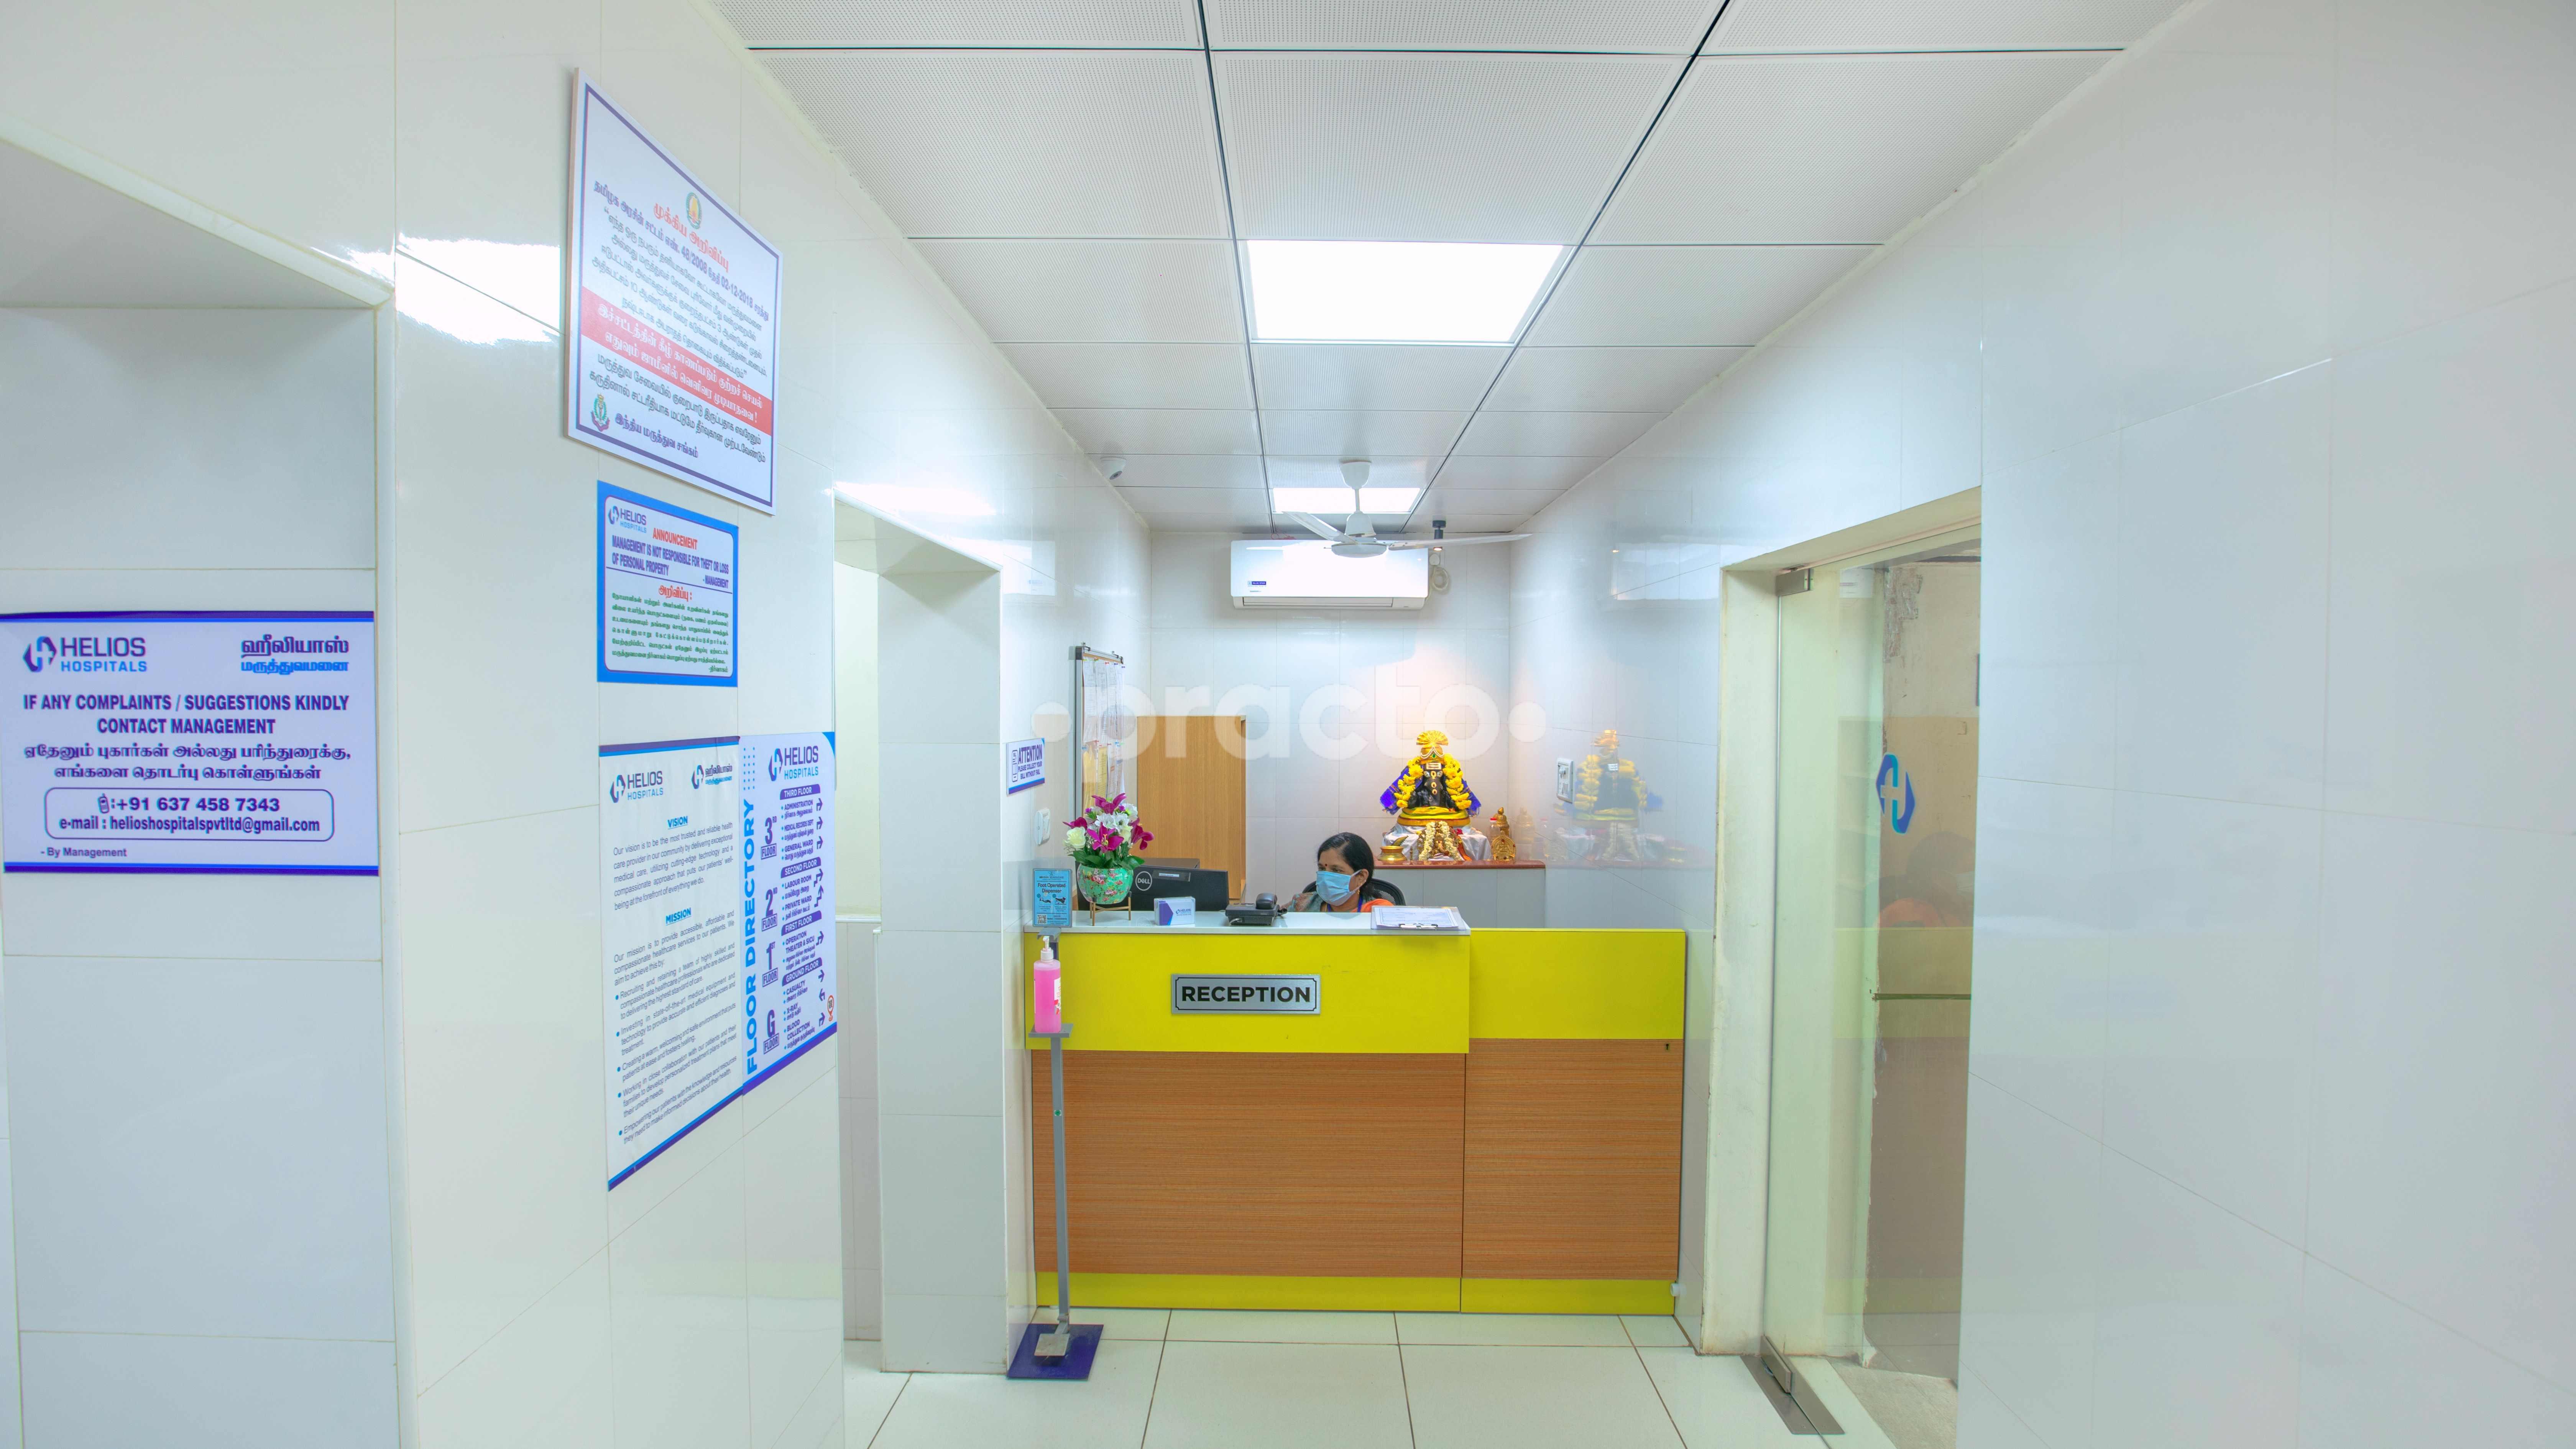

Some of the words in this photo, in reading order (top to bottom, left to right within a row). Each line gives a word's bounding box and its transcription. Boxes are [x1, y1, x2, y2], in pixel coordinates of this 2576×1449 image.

[654, 204, 686, 237] முக்கிய
[605, 332, 638, 357] எதுவும்
[598, 304, 656, 347] இச்சட்டத்தின்
[659, 338, 672, 358] கீழ்
[743, 390, 762, 408] செயல்
[615, 413, 641, 434] இந்திய
[643, 427, 675, 448] மருத்துவ
[677, 442, 698, 458] சங்கம்
[620, 508, 646, 525] HELIOS
[620, 521, 646, 533] HOSPITALS
[653, 528, 697, 549] ANNOUNCEMENT
[612, 535, 646, 554] MANAGEMENT
[647, 544, 651, 555] IS
[652, 545, 661, 557] NOT
[662, 548, 690, 565] RESPONSIBLE
[700, 558, 712, 570] THEFT
[713, 561, 719, 572] OR
[720, 563, 728, 574] LOSS
[612, 552, 618, 564] OF
[620, 554, 644, 570] PERSONAL
[646, 560, 669, 575] PROPERTY
[705, 575, 728, 588] MANAGEMENT
[60, 637, 145, 657] HELIOS
[241, 634, 348, 658] ஹீலியாஸ்
[61, 661, 146, 672] HOSPITALS
[241, 659, 348, 675] மருத்துவமனை
[23, 695, 37, 709] IF
[41, 695, 71, 709] ANY
[75, 695, 171, 710] COMPLAINTS
[184, 695, 291, 710] SUGGESTIONS
[295, 695, 349, 710] KINDLY
[97, 718, 166, 733] CONTACT
[170, 718, 275, 733] MANAGEMENT
[23, 743, 94, 760] ஏதேனும்
[97, 743, 169, 759] புகார்கள்
[172, 743, 237, 761] அல்லது
[785, 746, 818, 766] HELIOS
[1018, 744, 1042, 764] ATTENTION
[54, 763, 128, 777] எங்களை
[132, 764, 198, 781] தொடர்பு
[202, 764, 321, 781] கொள்ளுங்கள்
[627, 771, 662, 789] HELIOS
[785, 767, 818, 779] HOSPITALS
[628, 788, 663, 800] HOSPITALS
[156, 798, 189, 810] 637
[196, 798, 229, 811] 458
[235, 798, 279, 811] 7343
[785, 800, 813, 810] ADMINISTRATION
[59, 816, 98, 829] e-mail
[110, 816, 319, 834] helioshospitalspvtltd@gmail.com
[668, 816, 687, 827] VISION
[681, 830, 696, 840] trusted
[706, 825, 720, 833] reliable
[46, 847, 60, 858] By
[62, 847, 127, 859] Management
[626, 856, 646, 868] provider
[661, 846, 684, 857] community
[691, 840, 710, 849] delivering
[711, 835, 732, 844] exceptional
[762, 846, 775, 857] FLOOR
[785, 843, 802, 852] GENERAL
[614, 873, 634, 883] medical
[651, 863, 668, 873] utilizing
[671, 856, 696, 867] cutting-edge
[699, 849, 720, 859] technology
[785, 864, 802, 875] SECOND
[803, 859, 816, 869] FLOOR
[744, 798, 755, 967] DIRECTORY
[785, 879, 800, 889] LABOUR
[801, 875, 811, 883] ROOM
[785, 900, 800, 910] PRIVATE
[801, 895, 812, 904] WARD
[666, 909, 690, 923] MISSION
[763, 917, 776, 928] FLOOR
[786, 922, 797, 932] FIRST
[798, 915, 812, 927] FLOOR
[786, 931, 806, 945] OPERATION
[786, 941, 802, 953] THEATER
[806, 936, 814, 944] SICU
[763, 971, 776, 984] FLOOR
[787, 968, 804, 982] GROUND
[805, 960, 818, 972] FLOOR
[786, 981, 805, 995] CASUALTY
[1182, 986, 1309, 1002] RECEPTION
[787, 1003, 797, 1014] X-RAY
[746, 973, 757, 1074] FLOOR
[767, 1010, 775, 1038] G
[787, 1020, 800, 1032] BLOOD
[787, 1022, 810, 1040] COLLECTION
[765, 1036, 778, 1051] FLOOR
